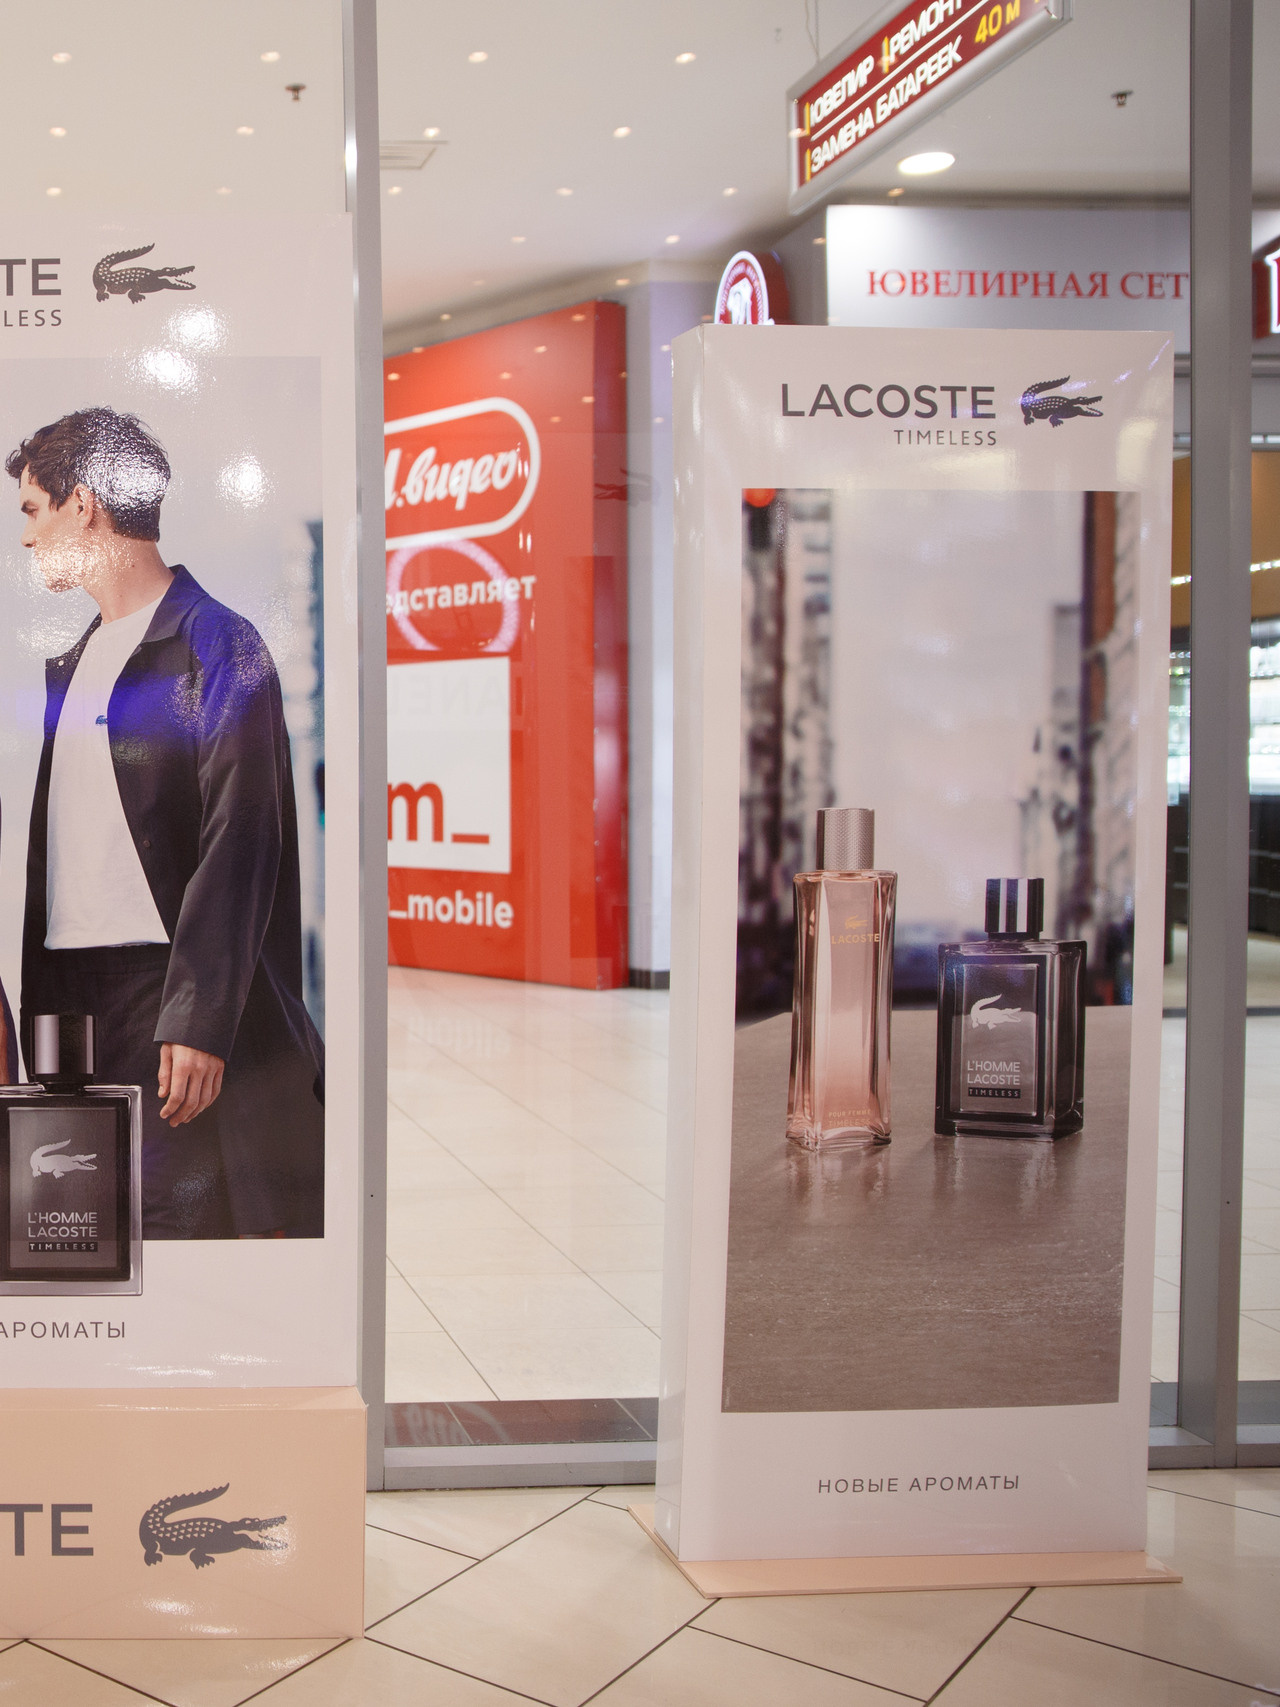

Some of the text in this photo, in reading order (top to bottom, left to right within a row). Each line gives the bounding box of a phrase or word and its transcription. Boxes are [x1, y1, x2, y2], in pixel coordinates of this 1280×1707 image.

[810, 54, 875, 127] ЮВЕЛИР
[811, 106, 875, 174] ЗАМЕНА
[876, 34, 963, 124] БАТАРЕЕК
[974, 3, 1003, 44] 40
[867, 269, 1110, 299] ЮВЕЛИРНАЯ
[781, 383, 996, 419] LACOSTE
[894, 429, 997, 446] TIMELESS
[831, 933, 880, 945] LACOSTE
[967, 1061, 1021, 1072] L'HOMME
[967, 1074, 1021, 1086] LACOSTE
[968, 1088, 1019, 1098] TIMELESS
[28, 1212, 97, 1224] L'HOMME
[28, 1226, 97, 1238] LACOSTE
[818, 1475, 1020, 1494] НОВЫЕ АРОМАТЫ
